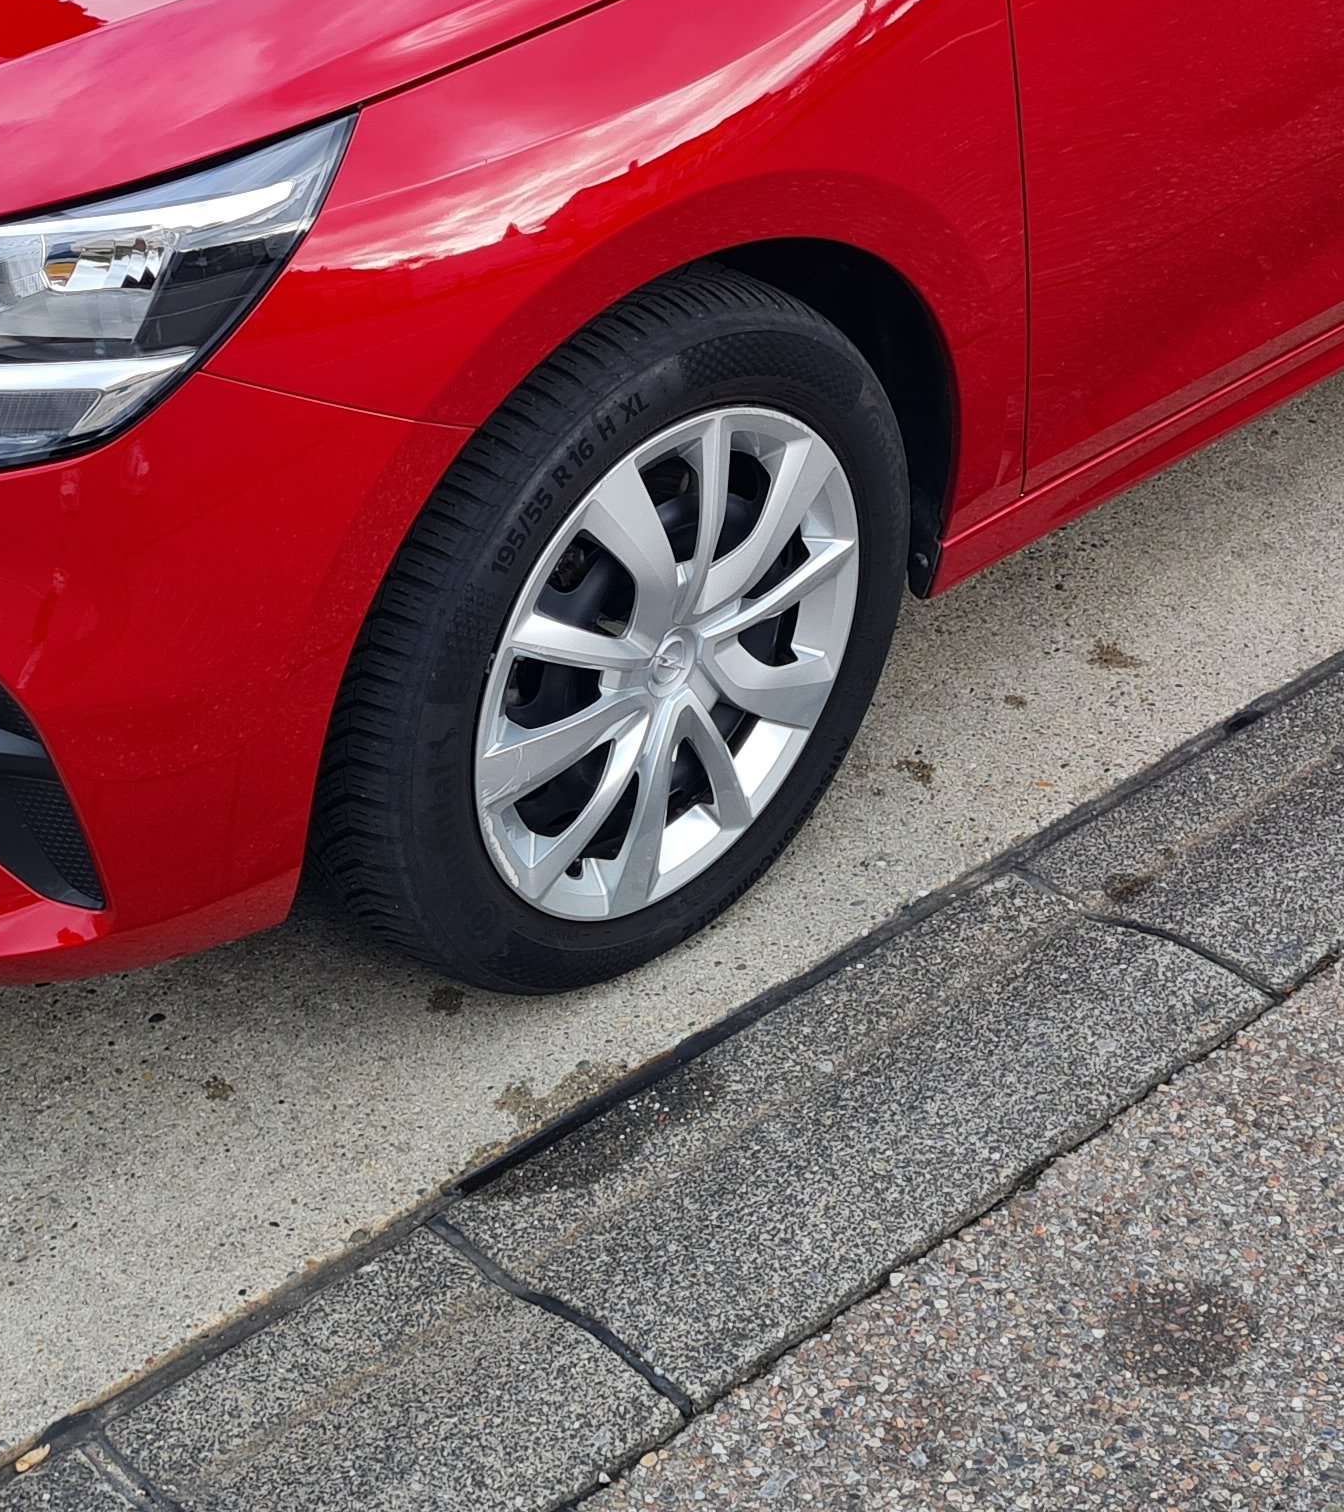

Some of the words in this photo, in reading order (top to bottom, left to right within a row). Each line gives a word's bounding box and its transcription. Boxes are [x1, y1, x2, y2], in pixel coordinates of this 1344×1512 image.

[490, 487, 554, 575] 195/55
[552, 464, 573, 489] R
[568, 437, 596, 467] 16
[596, 414, 617, 441] H
[618, 391, 651, 425] XL
